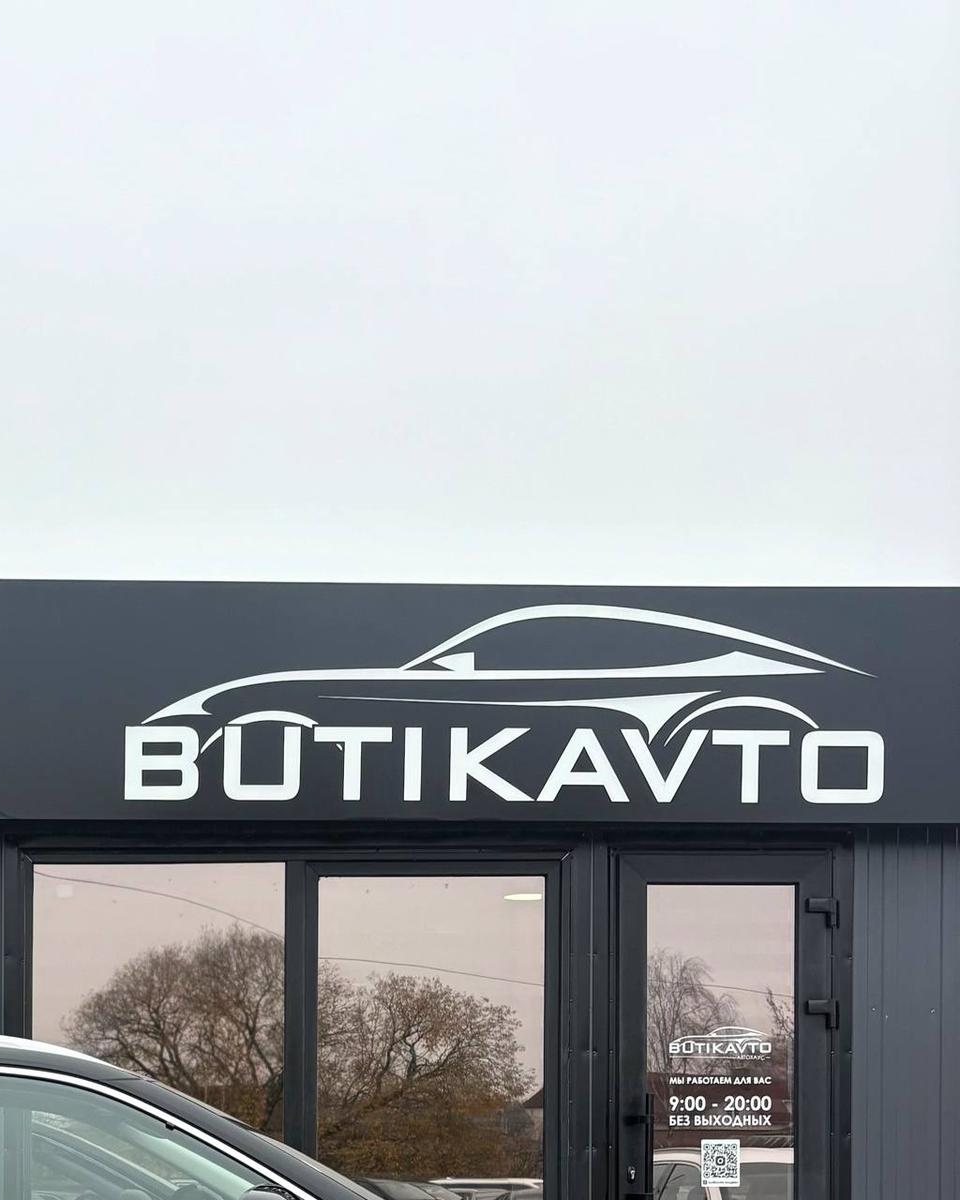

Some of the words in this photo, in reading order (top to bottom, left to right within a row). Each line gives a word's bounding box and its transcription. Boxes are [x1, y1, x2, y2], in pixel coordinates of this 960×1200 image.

[123, 724, 885, 805] BUTIKAVTO
[669, 1042, 772, 1054] BUTIKAVTO
[669, 1076, 685, 1085] МЫ
[687, 1076, 732, 1085] РАБОТАЕМ
[733, 1076, 752, 1086] ДЛЯ
[753, 1076, 772, 1085] ВАС
[669, 1095, 706, 1112] 9:00
[724, 1095, 772, 1112] 20:00
[669, 1114, 691, 1126] БЕЗ
[694, 1114, 772, 1127] ВЫХОДНЫХ
